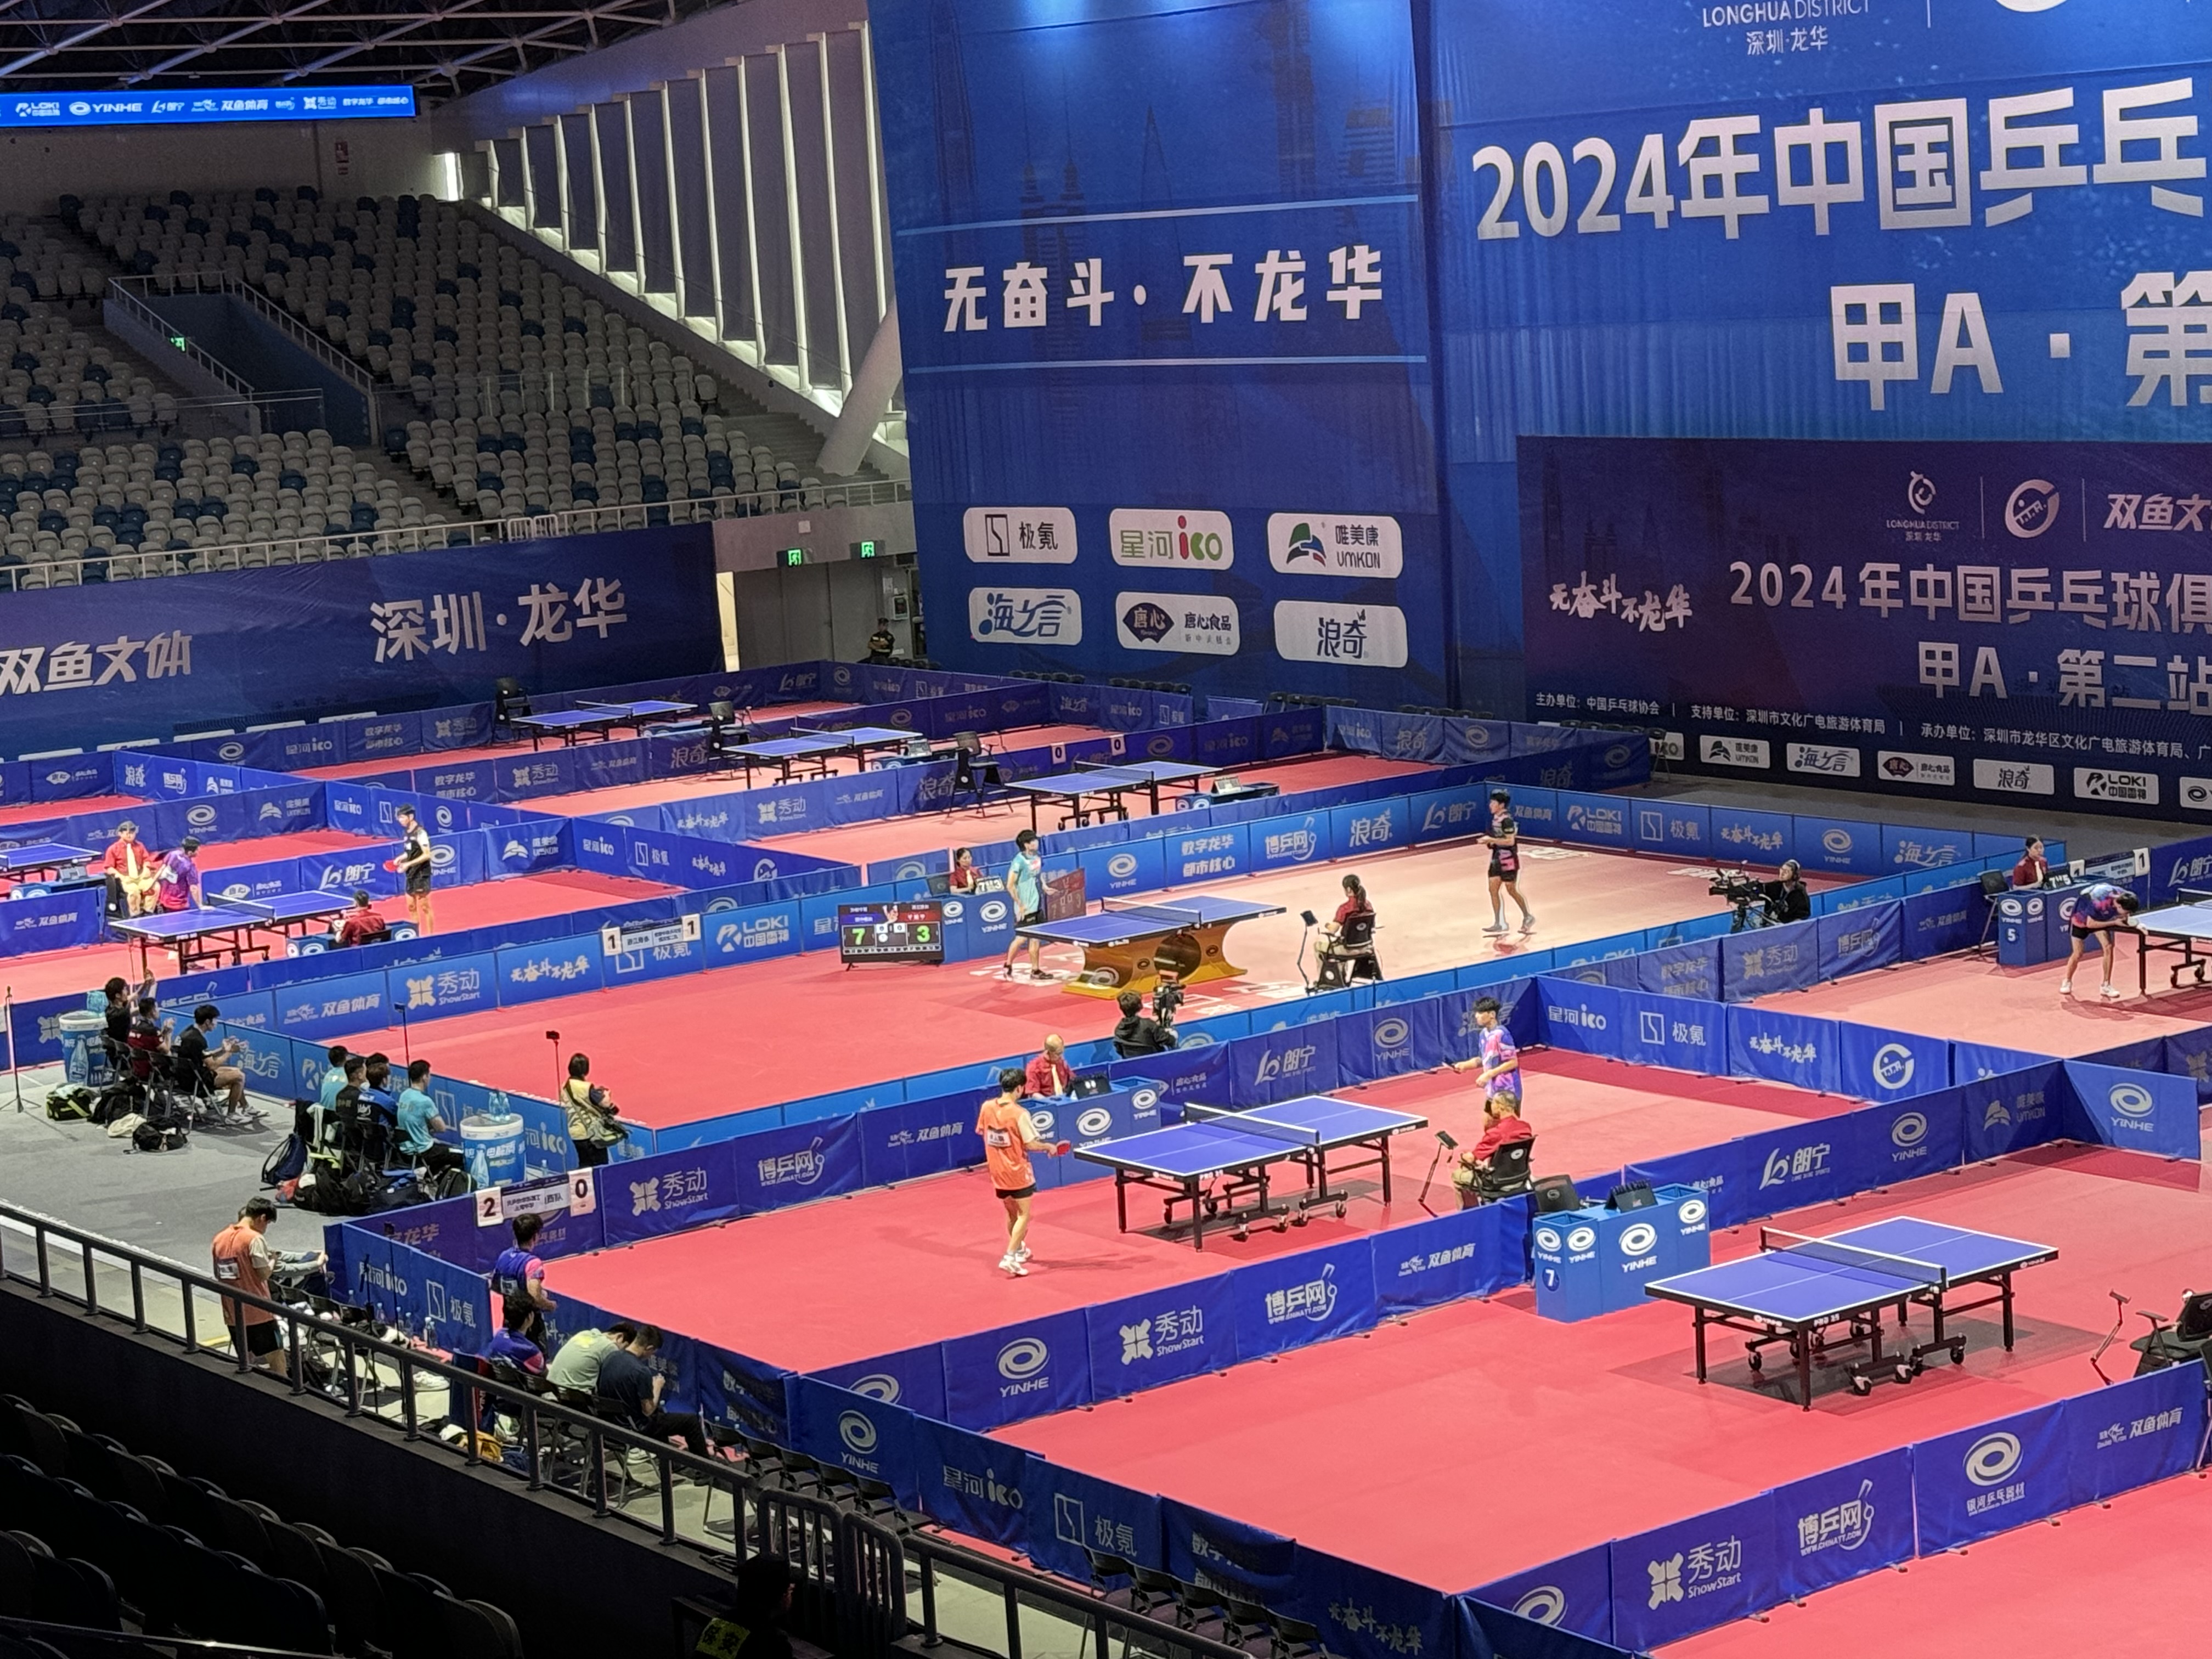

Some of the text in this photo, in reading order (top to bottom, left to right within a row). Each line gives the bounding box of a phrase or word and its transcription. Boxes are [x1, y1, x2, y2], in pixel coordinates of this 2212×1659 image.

[1703, 2, 1791, 27] LONGHUA
[1746, 25, 1829, 55] 深圳·龙华
[92, 103, 143, 113] YINHE
[1472, 77, 2208, 240] 2024年中国乒乓
[943, 245, 1384, 332] 无奋斗·不龙华
[2103, 494, 2212, 532] 双鱼文
[1019, 521, 1059, 550] 极氪
[1335, 524, 1380, 546] 唯美康
[1729, 561, 2212, 634] 2024年中国乒乓球俱
[370, 578, 627, 663] 深圳·龙华
[1318, 608, 1367, 659] 浪奇
[0, 631, 191, 695] 双鱼文体
[1055, 746, 1062, 759] 0
[1114, 738, 1121, 751] 0
[532, 764, 558, 778] 秀动
[2108, 775, 2146, 787] LOKI
[777, 798, 806, 814] 秀动
[1448, 801, 1477, 823] 朗宁
[1587, 808, 1622, 821] LOKI
[1350, 808, 1393, 848] 浪奇
[1671, 820, 1700, 840] 极氪
[1181, 834, 1234, 856] 数字龙华
[1265, 830, 1308, 854] 博乒网
[2139, 853, 2145, 868] 1
[430, 866, 456, 877] INHE
[978, 879, 1003, 891] 7 3
[1109, 879, 1137, 889] YINHE
[687, 920, 695, 935] 1
[742, 915, 789, 932] LOKI
[814, 918, 839, 935] 星
[607, 934, 616, 949] 1
[852, 928, 865, 945] 7
[917, 926, 930, 943] 3
[2007, 929, 2017, 941] 5
[437, 967, 480, 996] 秀动
[321, 994, 381, 1018] 双鱼体育
[439, 992, 481, 1006] ShowStart
[1672, 1022, 1706, 1046] 极氪
[1283, 1045, 1316, 1073] 朗宁
[1376, 1047, 1410, 1060] YINHE
[917, 1121, 964, 1142] 双鱼体育
[2111, 1116, 2154, 1132] YINHE
[1792, 1143, 1830, 1175] 朗宁
[1892, 1145, 1927, 1161] YINHE
[758, 1150, 815, 1182] 博乒网
[575, 1179, 588, 1198] 0
[663, 1167, 708, 1200] 秀动
[483, 1197, 496, 1217] 2
[1680, 1223, 1706, 1236] YINHE
[1427, 1243, 1476, 1269] 双鱼体育
[1538, 1252, 1561, 1263] YINHE
[1568, 1251, 1595, 1263] YINHE
[1622, 1255, 1657, 1272] YINHE
[1545, 1268, 1554, 1286] 7
[1266, 1279, 1326, 1317] 博乒网
[1155, 1305, 1203, 1344] 秀动
[1156, 1335, 1204, 1356] ShowStart
[1000, 1377, 1048, 1397] YINHE
[2129, 1407, 2183, 1440] 双鱼体育
[841, 1451, 879, 1472] YINHE
[1798, 1500, 1862, 1548] 博乒网
[1094, 1515, 1137, 1557] 极氪
[1688, 1535, 1742, 1584] 秀动
[1688, 1573, 1742, 1598] ShowStart
